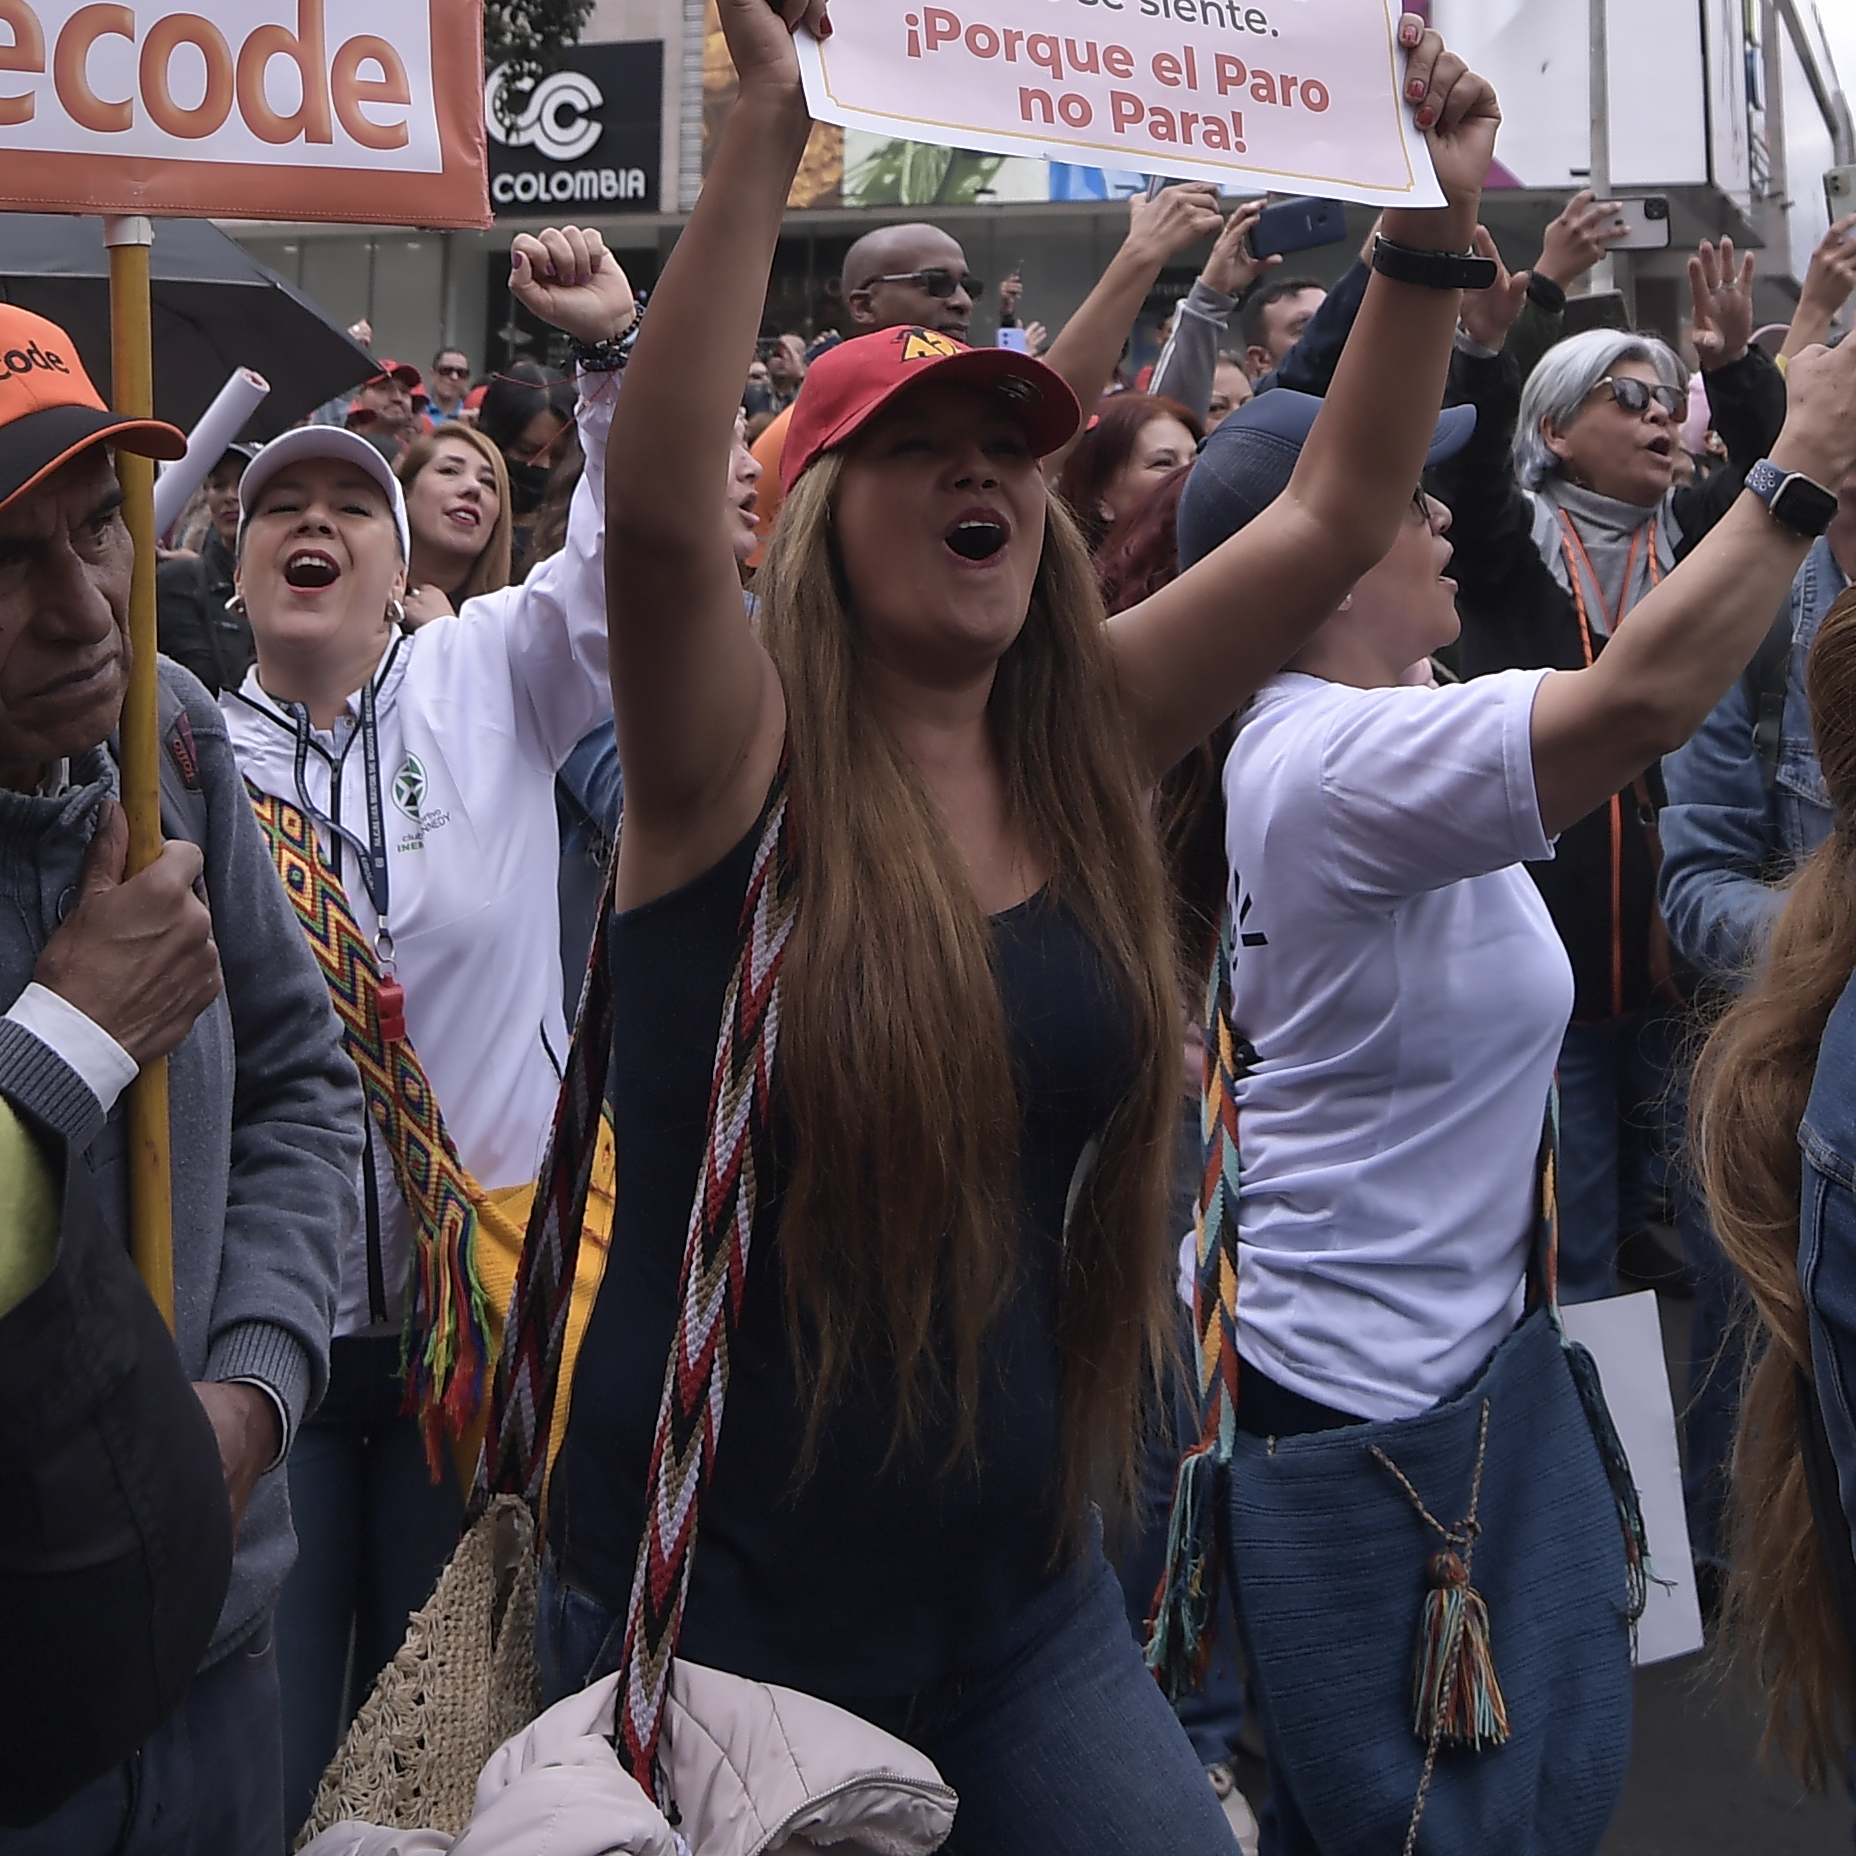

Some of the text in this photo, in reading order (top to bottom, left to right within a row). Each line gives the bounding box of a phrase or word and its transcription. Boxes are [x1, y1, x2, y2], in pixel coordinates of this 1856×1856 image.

[905, 6, 1330, 113] ¡Porque el Paro
[1018, 86, 1248, 154] no Para!
[493, 168, 646, 203] COLOMBIA
